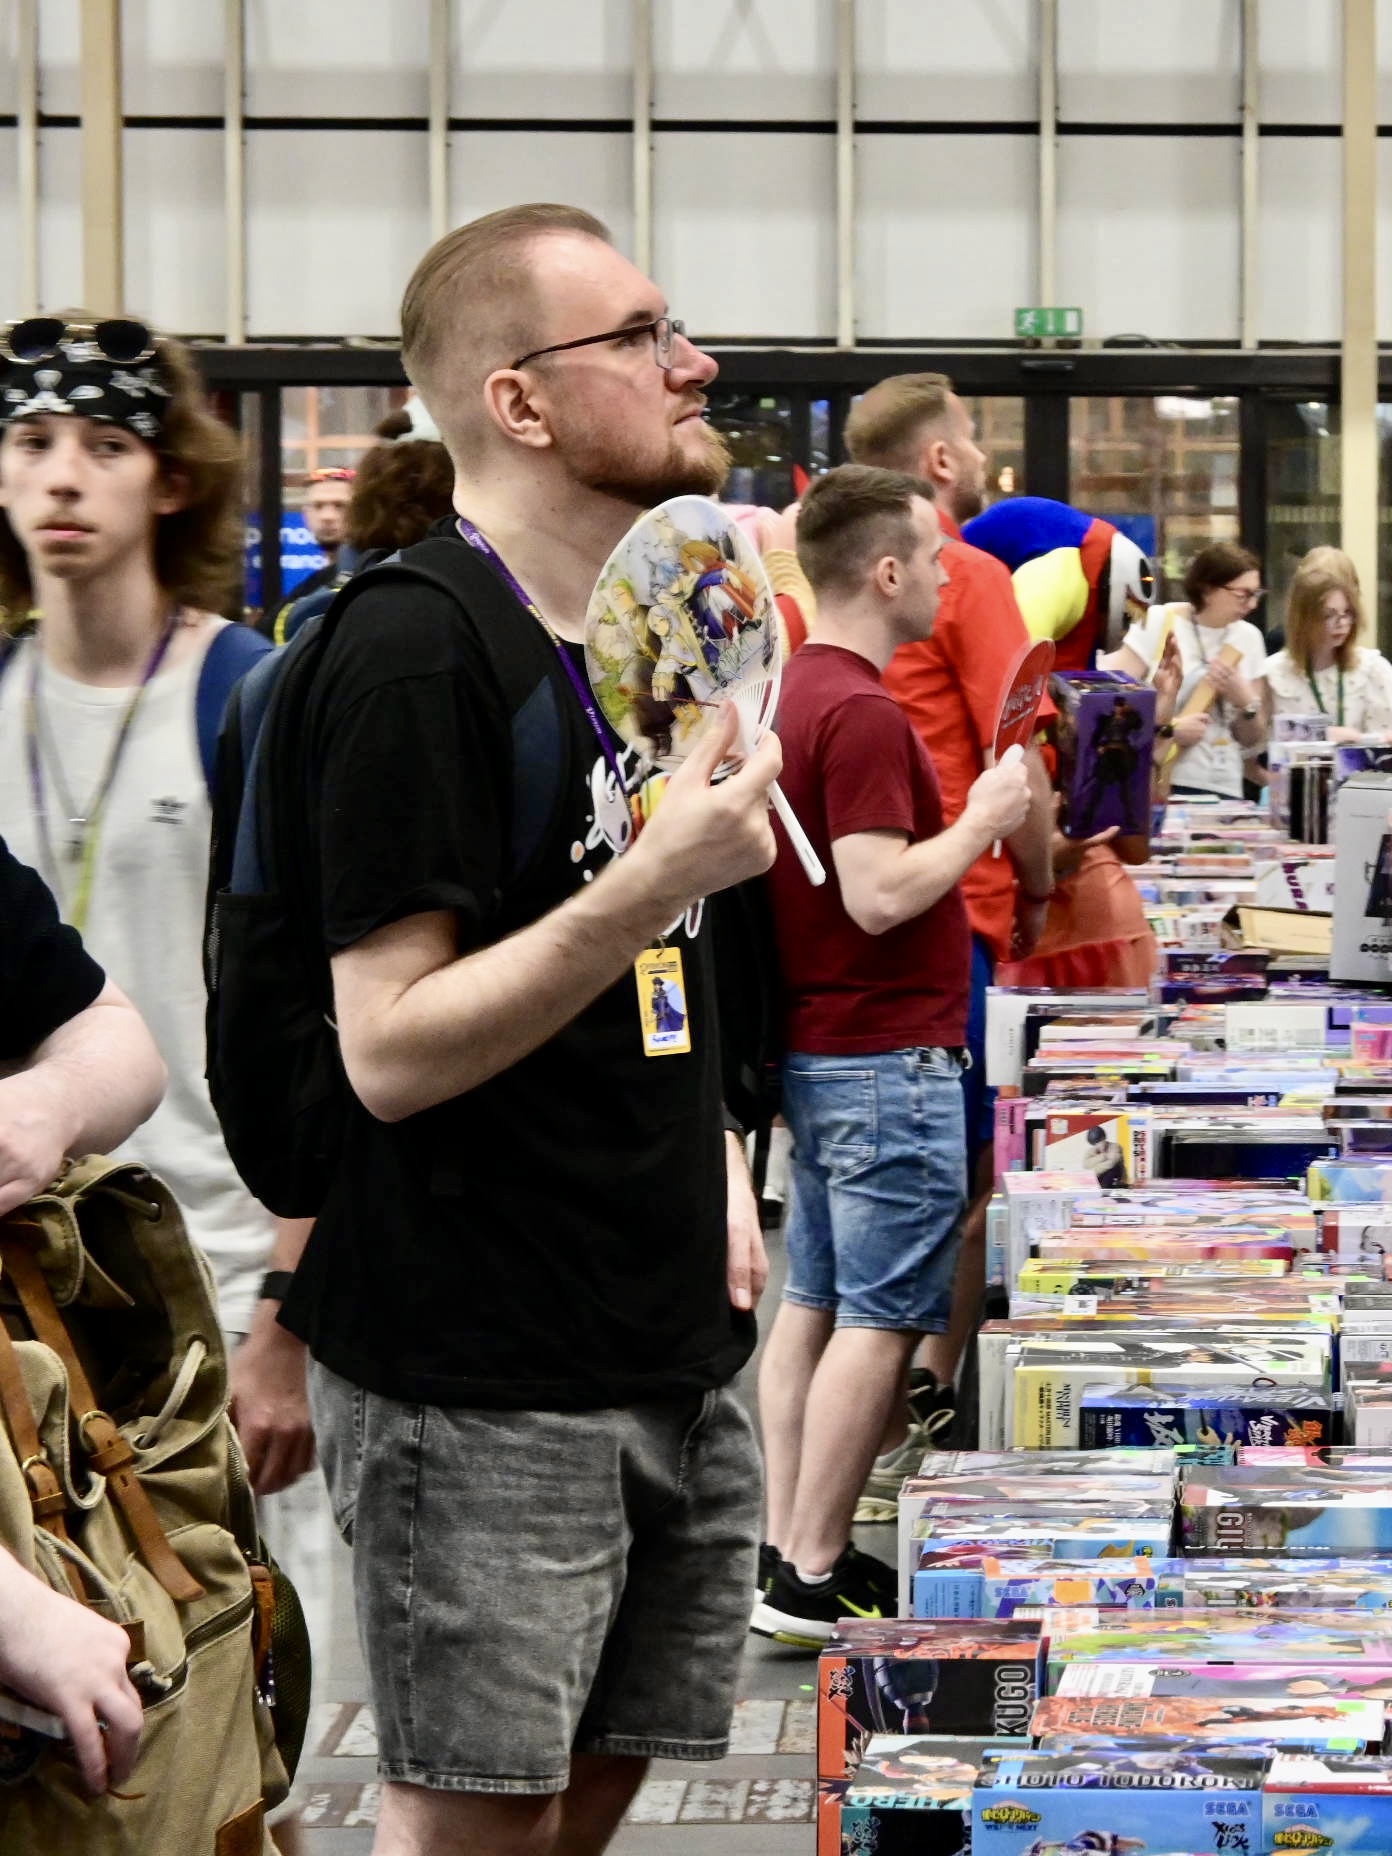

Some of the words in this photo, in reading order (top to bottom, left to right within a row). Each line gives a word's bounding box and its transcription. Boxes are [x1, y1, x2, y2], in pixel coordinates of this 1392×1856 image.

[850, 1795, 941, 1809] HERO
[1204, 1802, 1250, 1816] SEGA
[1274, 1803, 1318, 1818] SEGA
